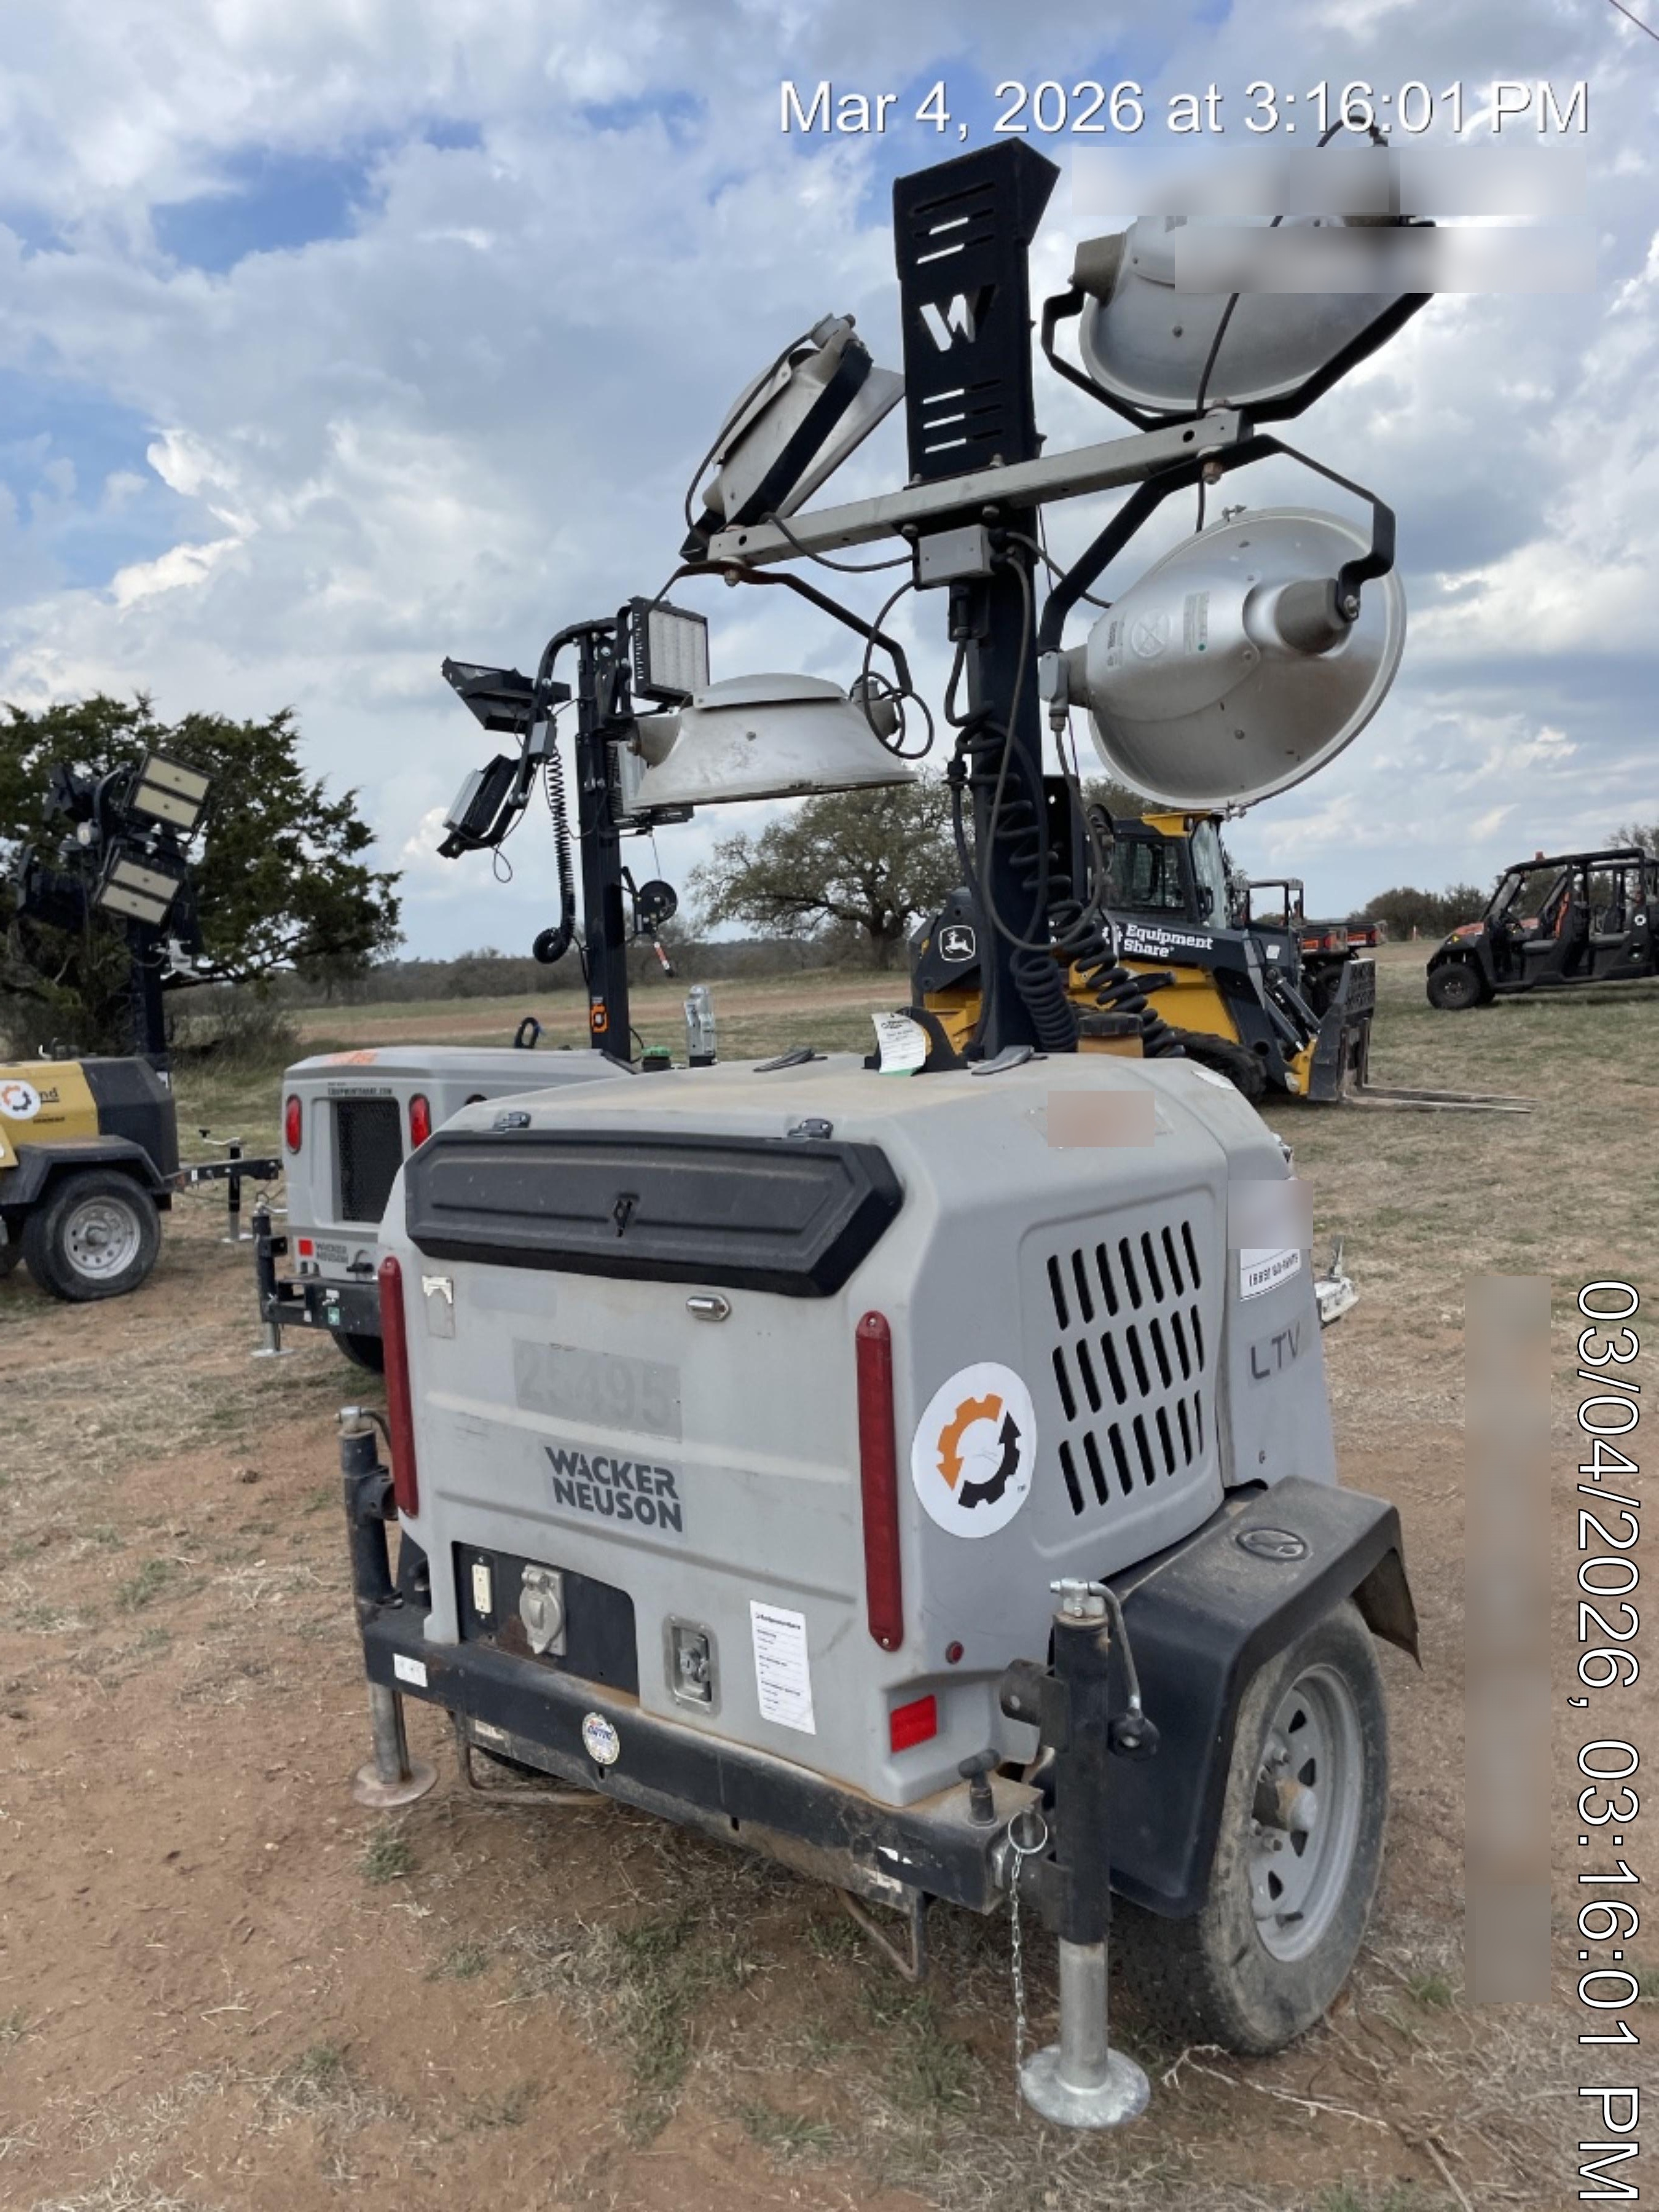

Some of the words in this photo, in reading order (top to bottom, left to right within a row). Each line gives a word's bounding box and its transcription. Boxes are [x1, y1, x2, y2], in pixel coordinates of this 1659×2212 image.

[1124, 938, 1169, 957] Share
[1126, 923, 1214, 950] Equipment
[544, 1446, 679, 1499] WACKER
[552, 1476, 683, 1532] NEUSON
